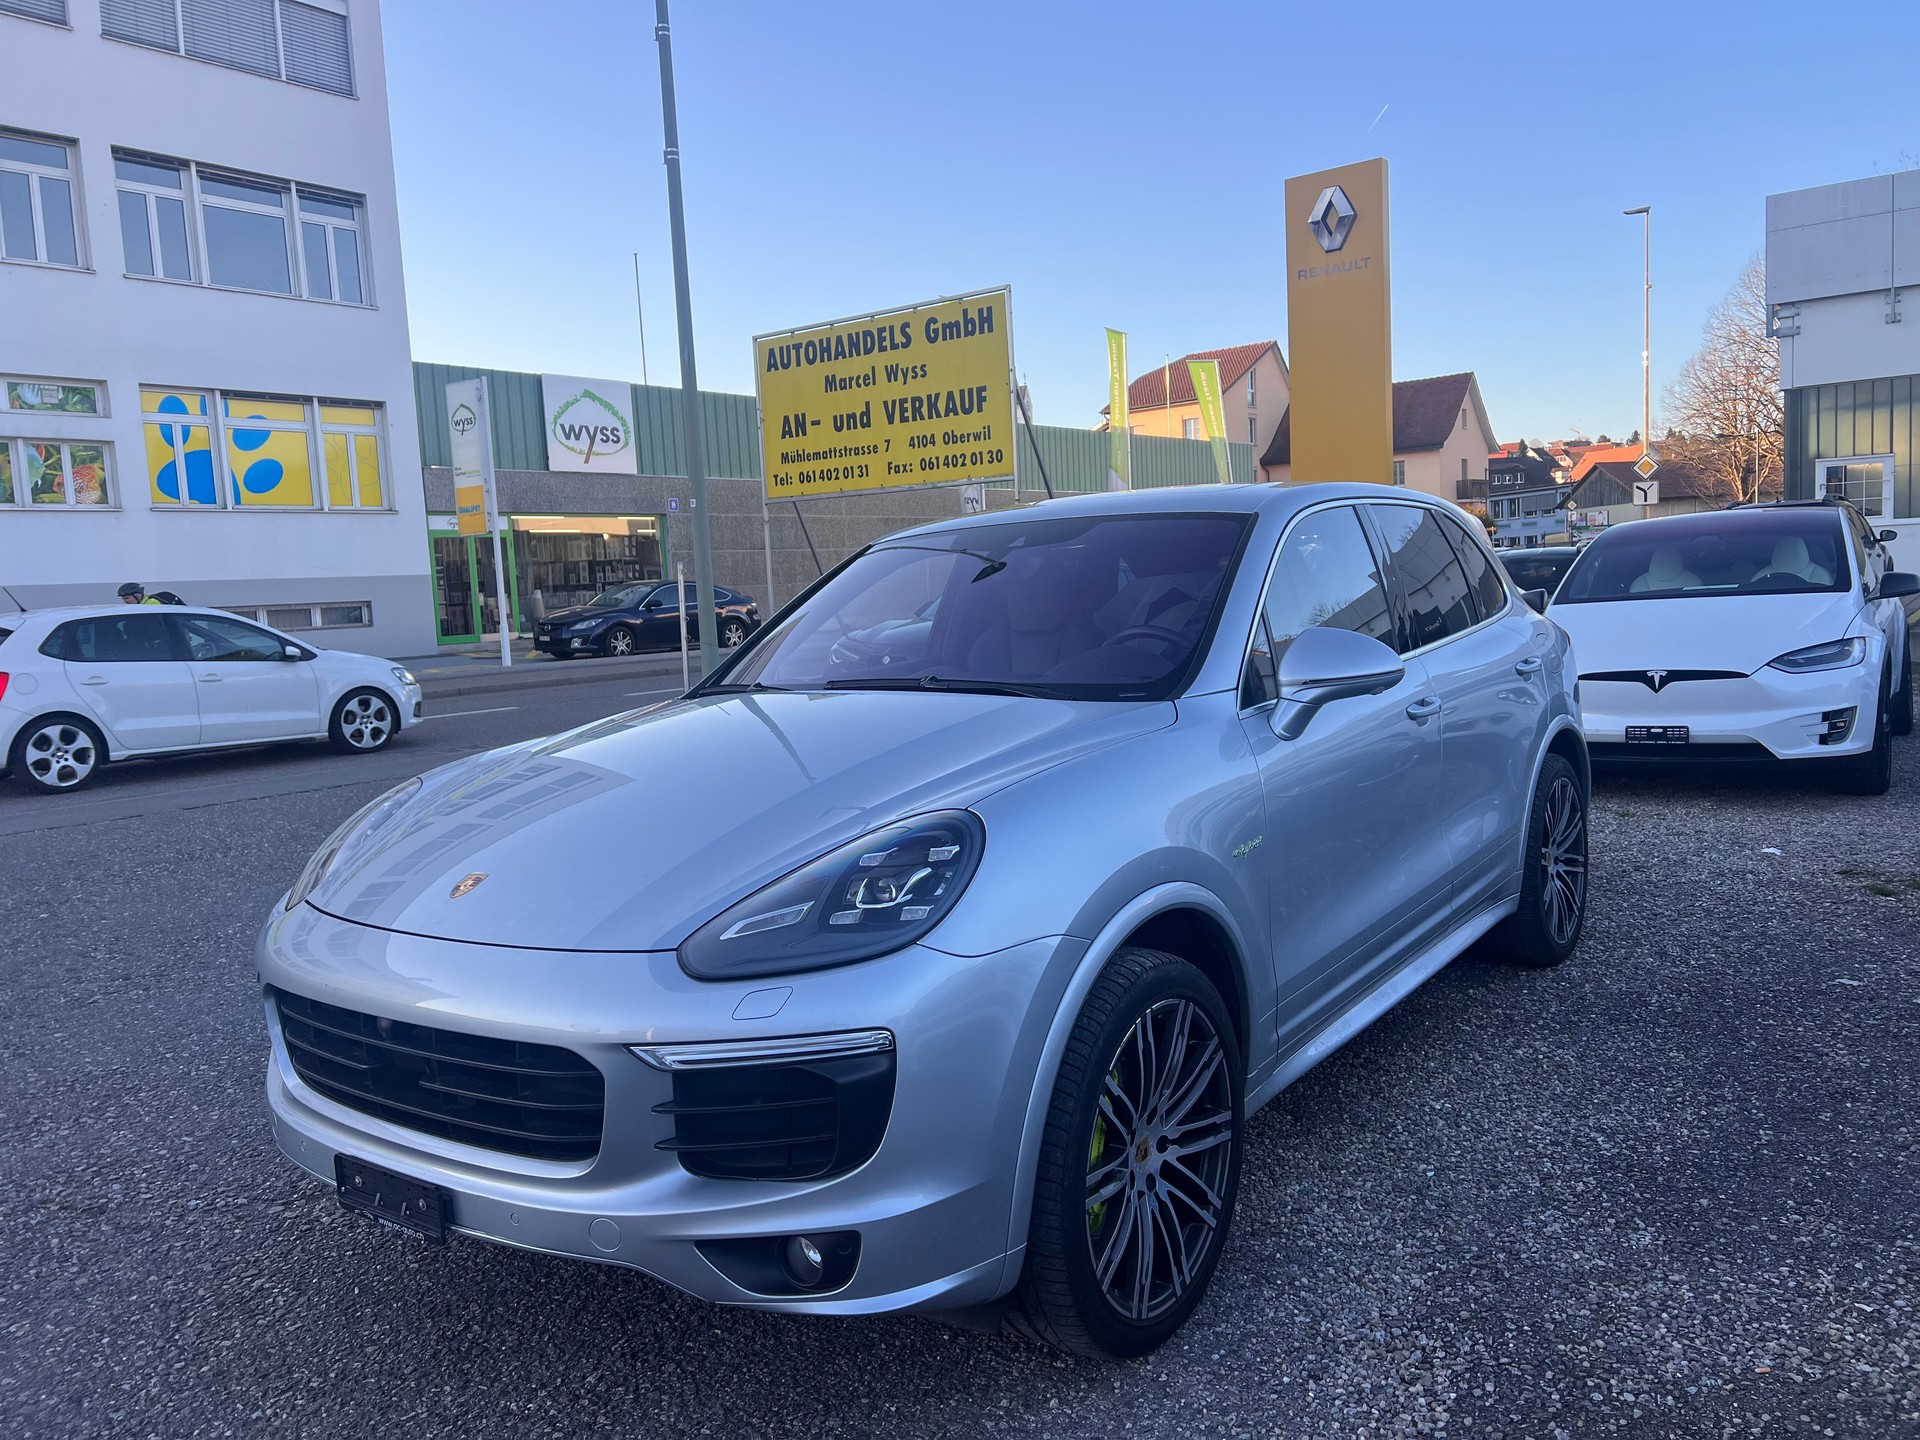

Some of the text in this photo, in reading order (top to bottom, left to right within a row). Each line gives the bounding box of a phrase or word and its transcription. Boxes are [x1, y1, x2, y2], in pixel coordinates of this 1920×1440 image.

[1297, 256, 1371, 280] RENAULT
[766, 305, 994, 373] AUTOHANDELS GmbH
[824, 363, 928, 393] Marcel Wyss
[453, 416, 474, 436] wyss
[780, 385, 988, 440] AN- und VERKAUF
[559, 423, 621, 465] wyss
[780, 424, 991, 465] Mühlemattstrasse 7 4104 Oberwil
[773, 471, 793, 487] Tel:
[887, 461, 914, 475] Fax:
[671, 500, 677, 509] 8
